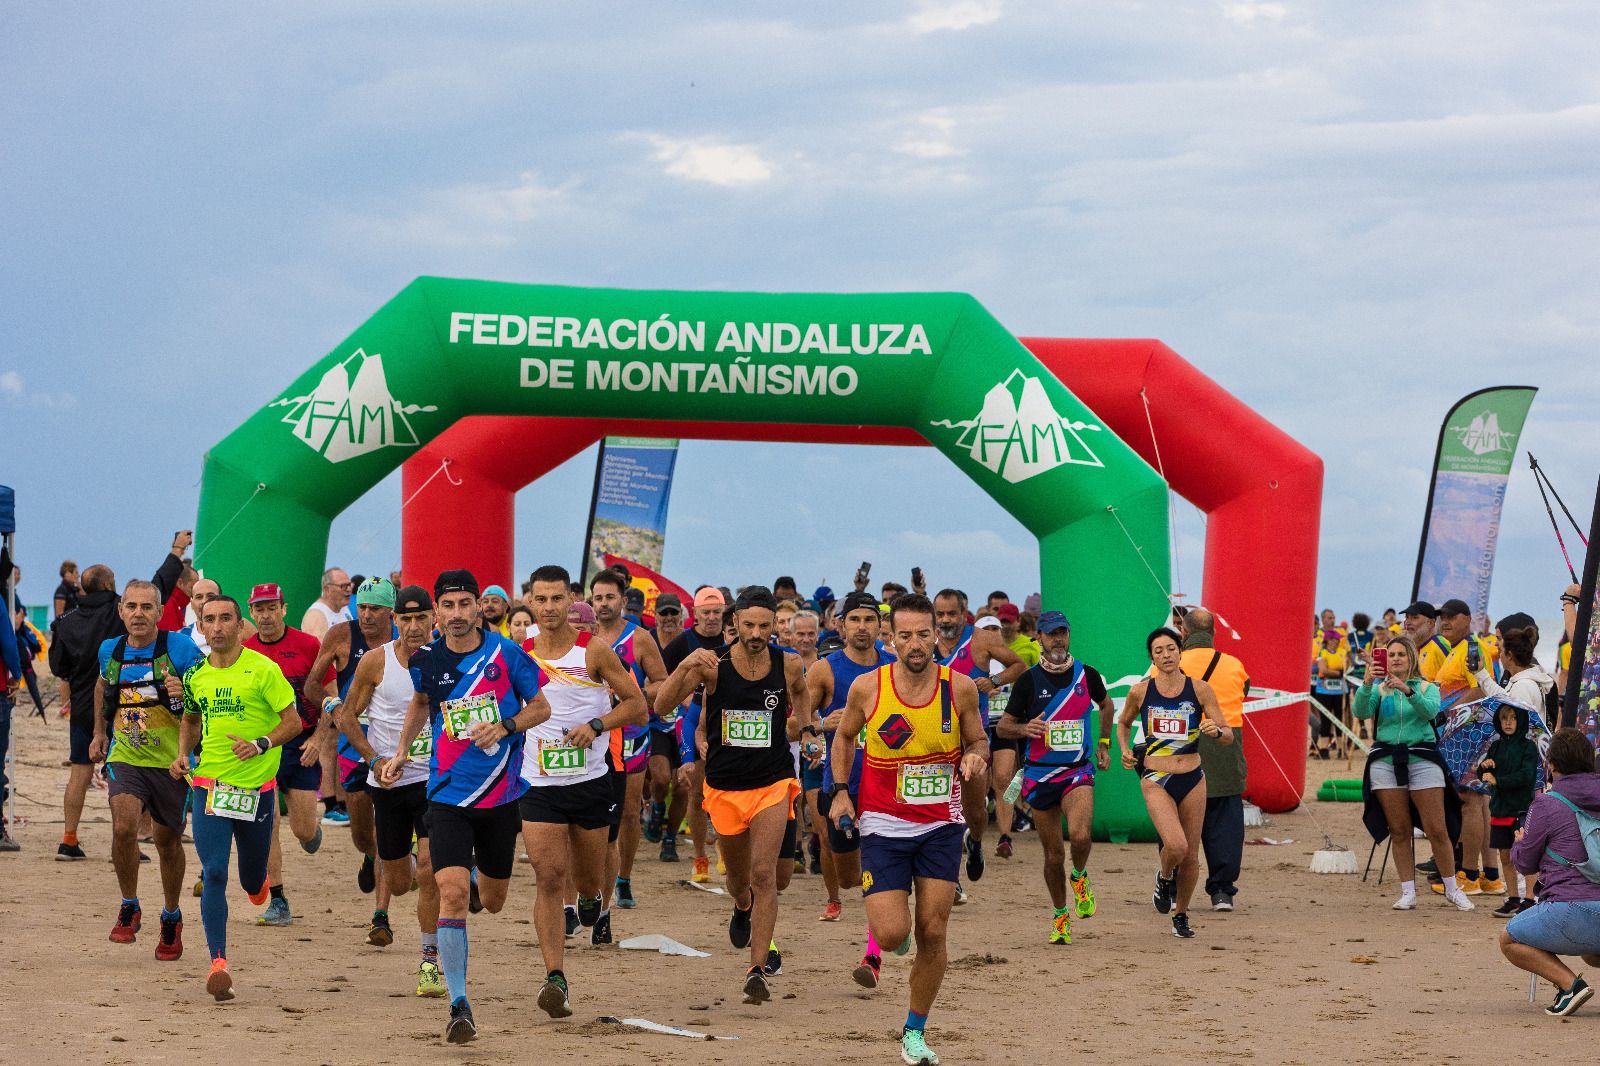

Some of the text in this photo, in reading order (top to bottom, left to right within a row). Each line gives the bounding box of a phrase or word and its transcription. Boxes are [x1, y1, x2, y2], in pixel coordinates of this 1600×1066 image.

[449, 312, 933, 356] FEDERACIÓN ANDALUZA
[519, 355, 859, 396] DE MONTAÑISMO
[304, 397, 387, 456] FAM
[979, 420, 1063, 475] FAM
[215, 687, 233, 698] VIII
[212, 698, 236, 707] TRAIL
[730, 722, 767, 739] 302
[1159, 719, 1180, 733] 50
[1052, 730, 1082, 744] 343
[547, 750, 579, 768] 211
[906, 777, 948, 796] 353
[215, 792, 253, 812] 249
